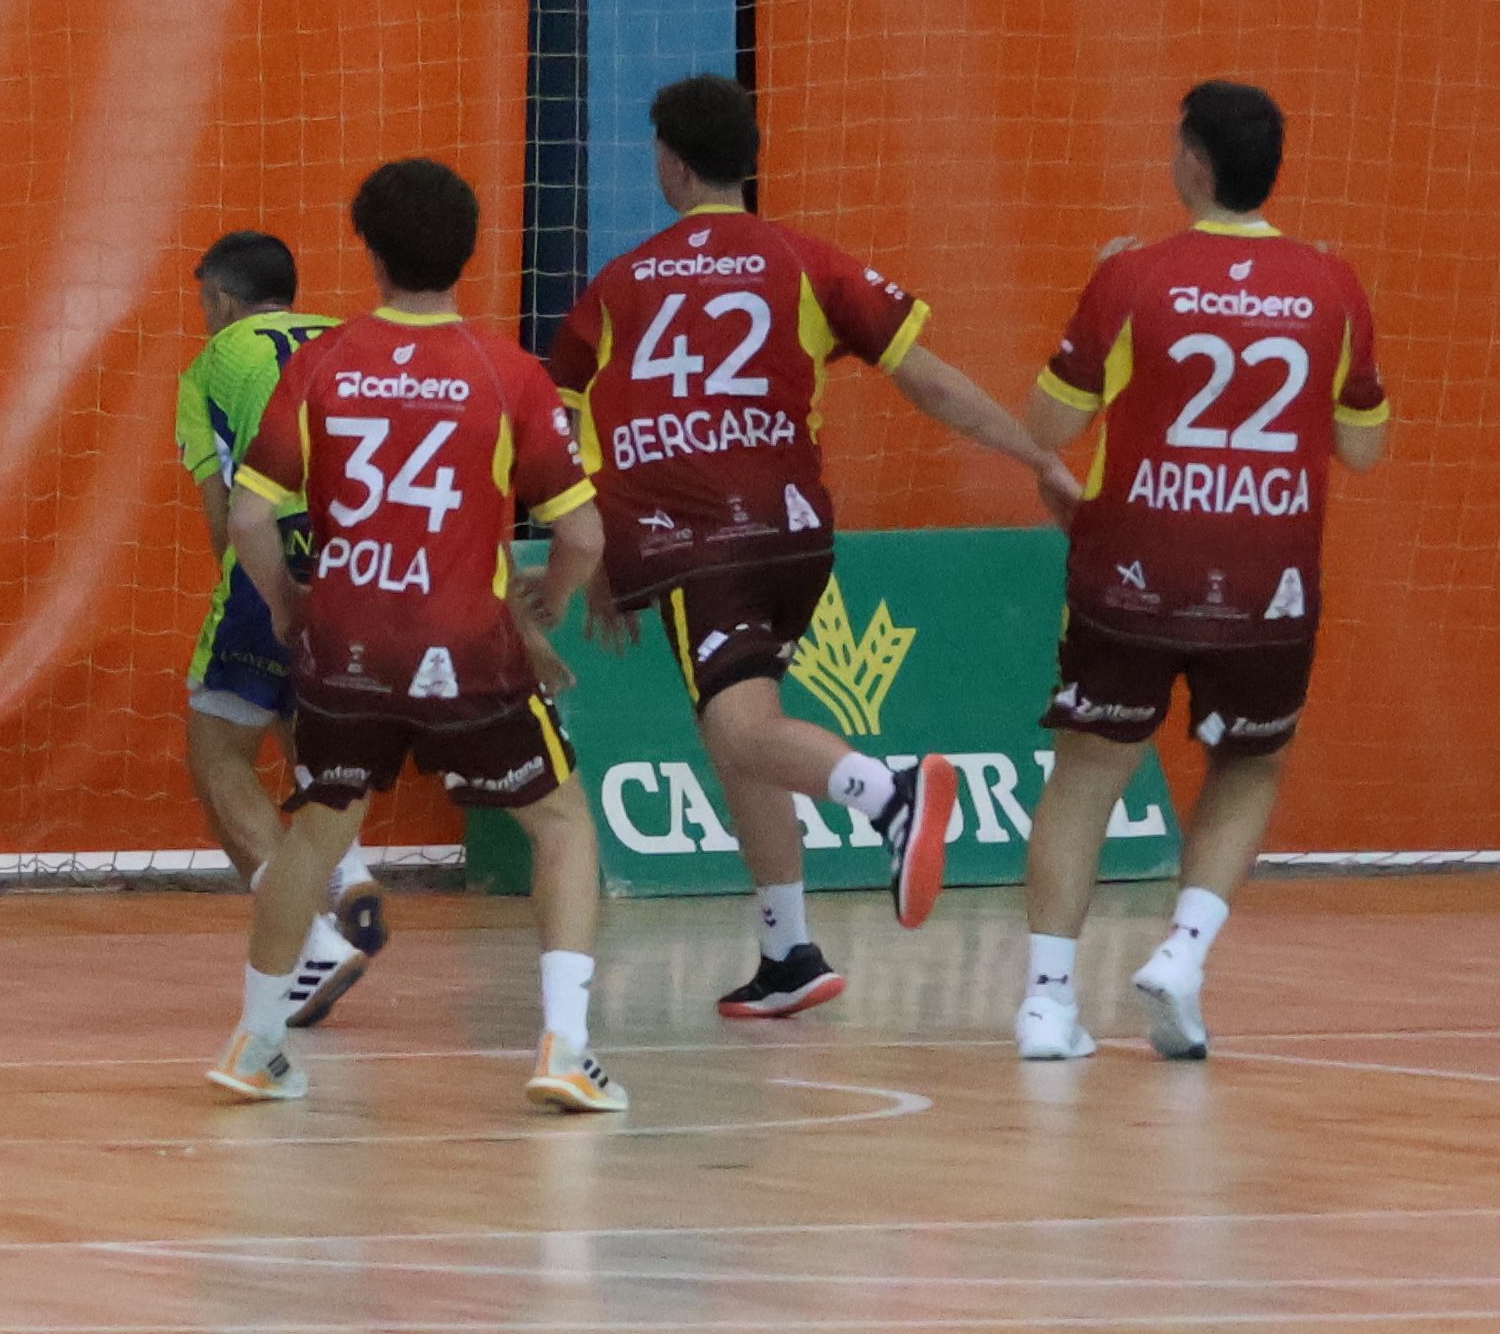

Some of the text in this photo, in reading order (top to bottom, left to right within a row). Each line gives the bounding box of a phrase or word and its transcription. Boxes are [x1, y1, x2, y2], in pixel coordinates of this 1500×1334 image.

[631, 290, 772, 398] 42
[1165, 332, 1310, 453] 22
[325, 417, 463, 534] 34
[612, 407, 796, 470] BERGARA
[1127, 458, 1310, 516] ARRIAGA
[317, 536, 432, 595] POLA
